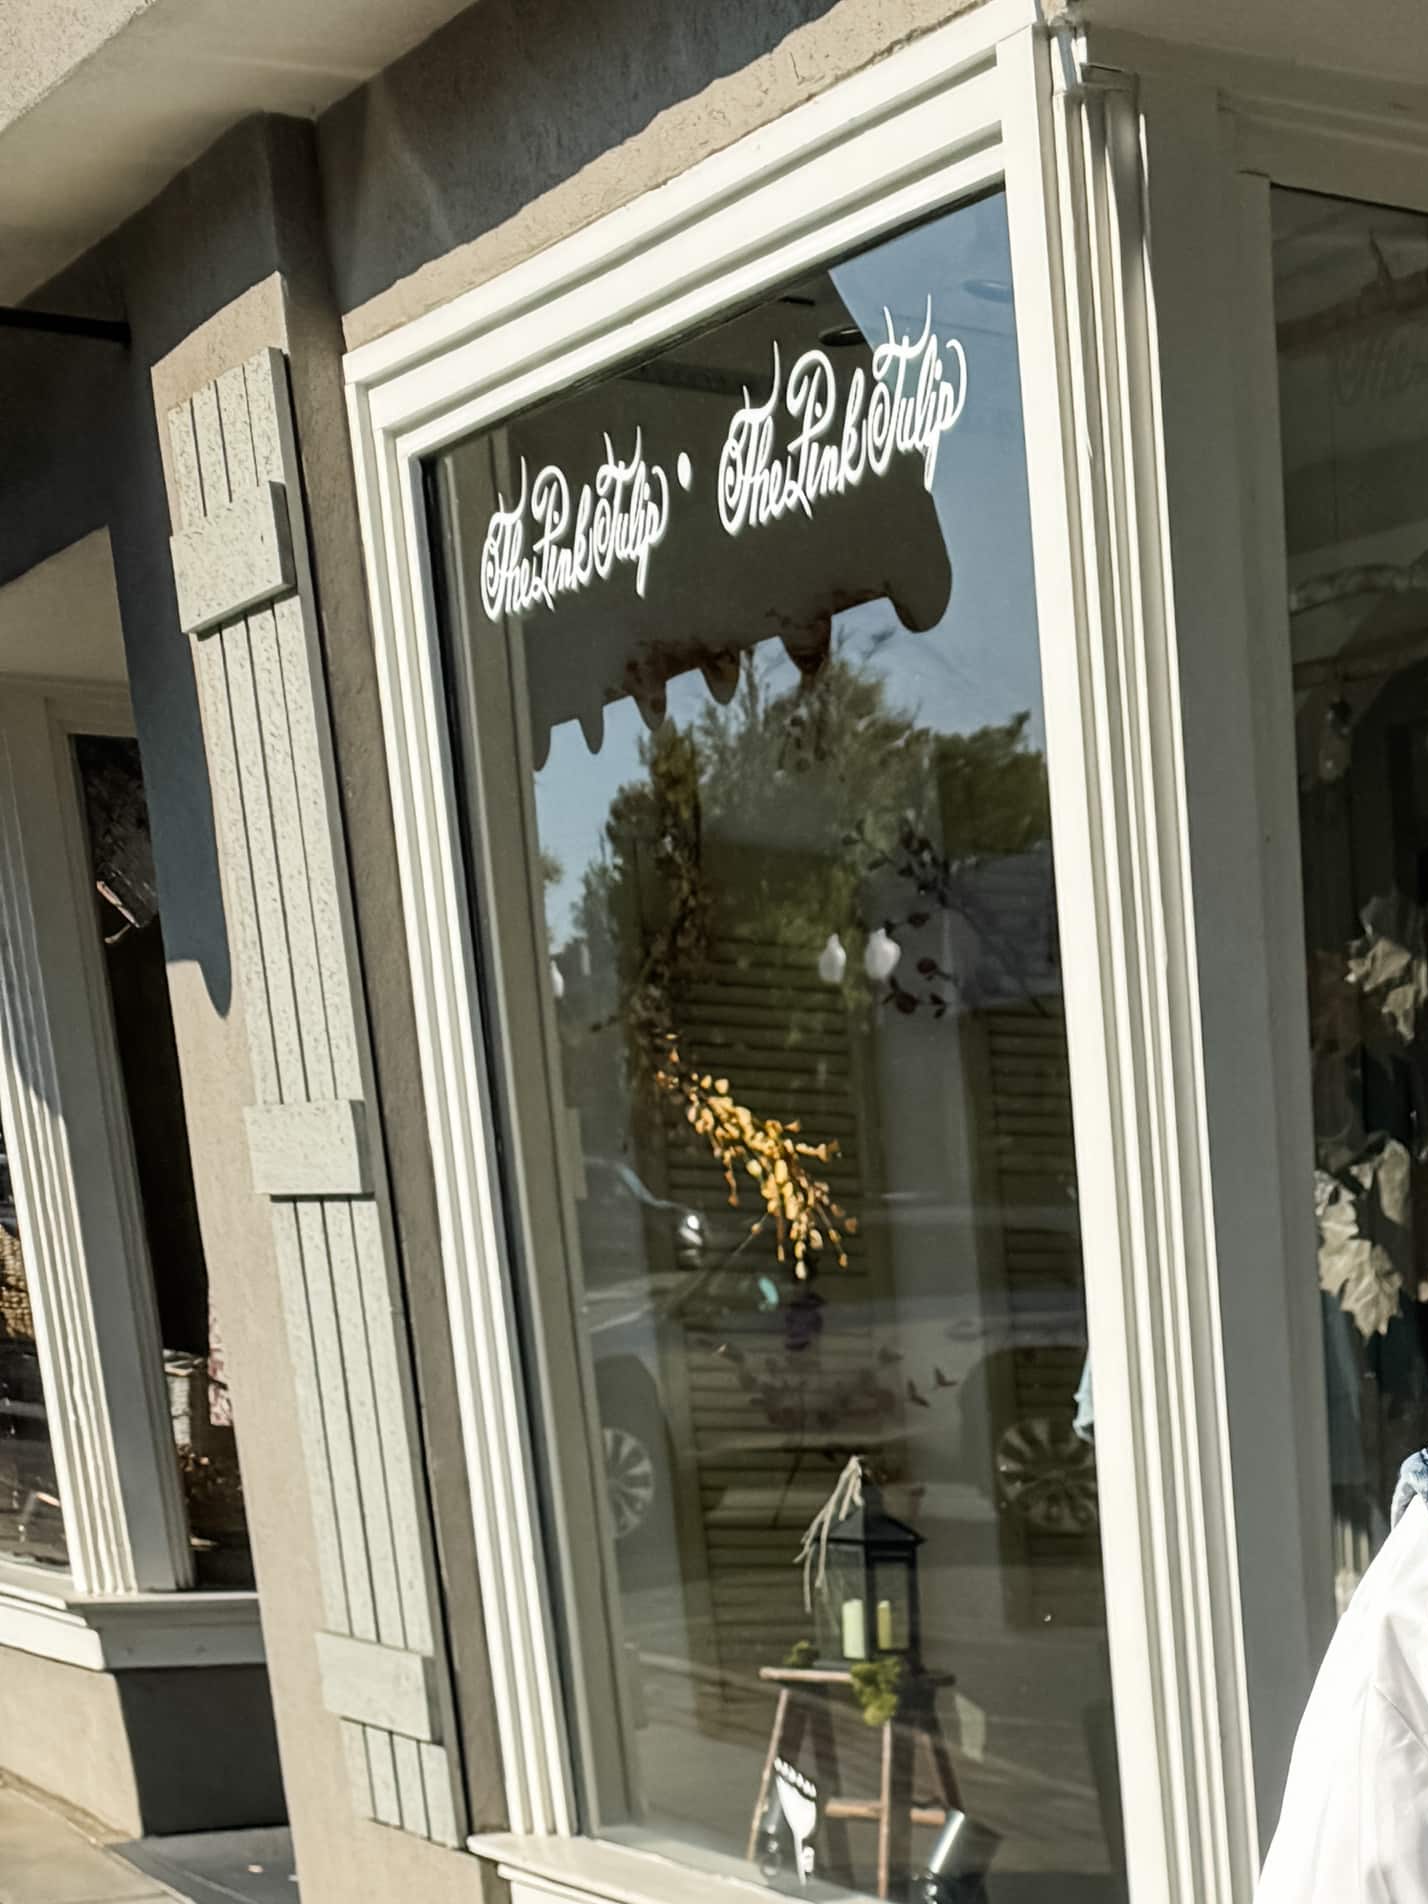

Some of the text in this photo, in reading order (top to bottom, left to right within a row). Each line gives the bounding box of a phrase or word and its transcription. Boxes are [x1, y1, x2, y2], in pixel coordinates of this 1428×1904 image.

[480, 294, 967, 621] The Pink Tulip The Pink Tulip
